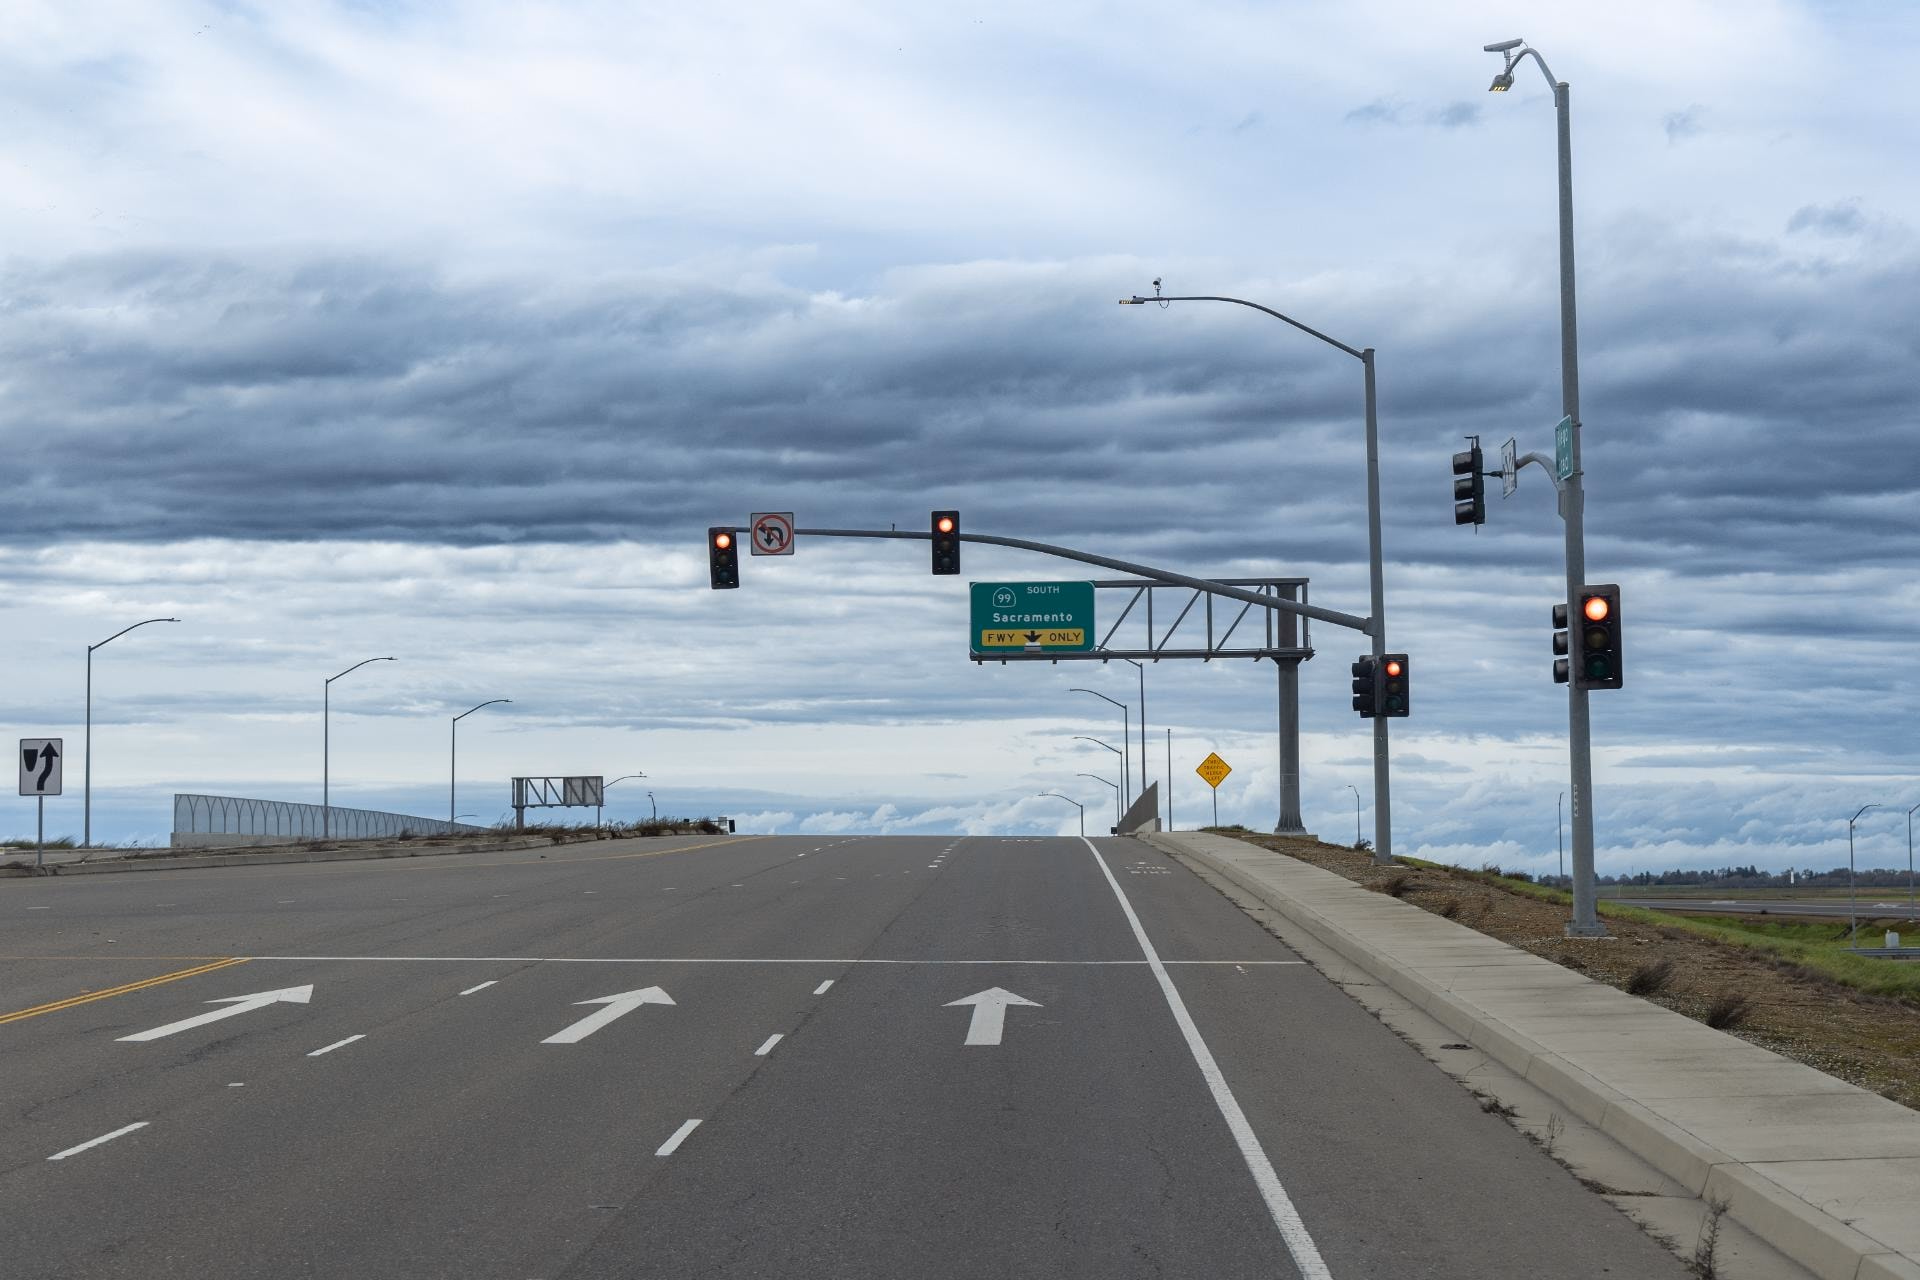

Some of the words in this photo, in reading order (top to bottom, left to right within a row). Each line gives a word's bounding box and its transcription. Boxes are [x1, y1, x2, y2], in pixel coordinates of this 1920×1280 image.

[1026, 586, 1060, 594] SOUTH
[997, 593, 1011, 603] 99
[993, 612, 1073, 622] Sacramento
[987, 633, 1015, 642] FWY
[1049, 632, 1081, 642] ONLY
